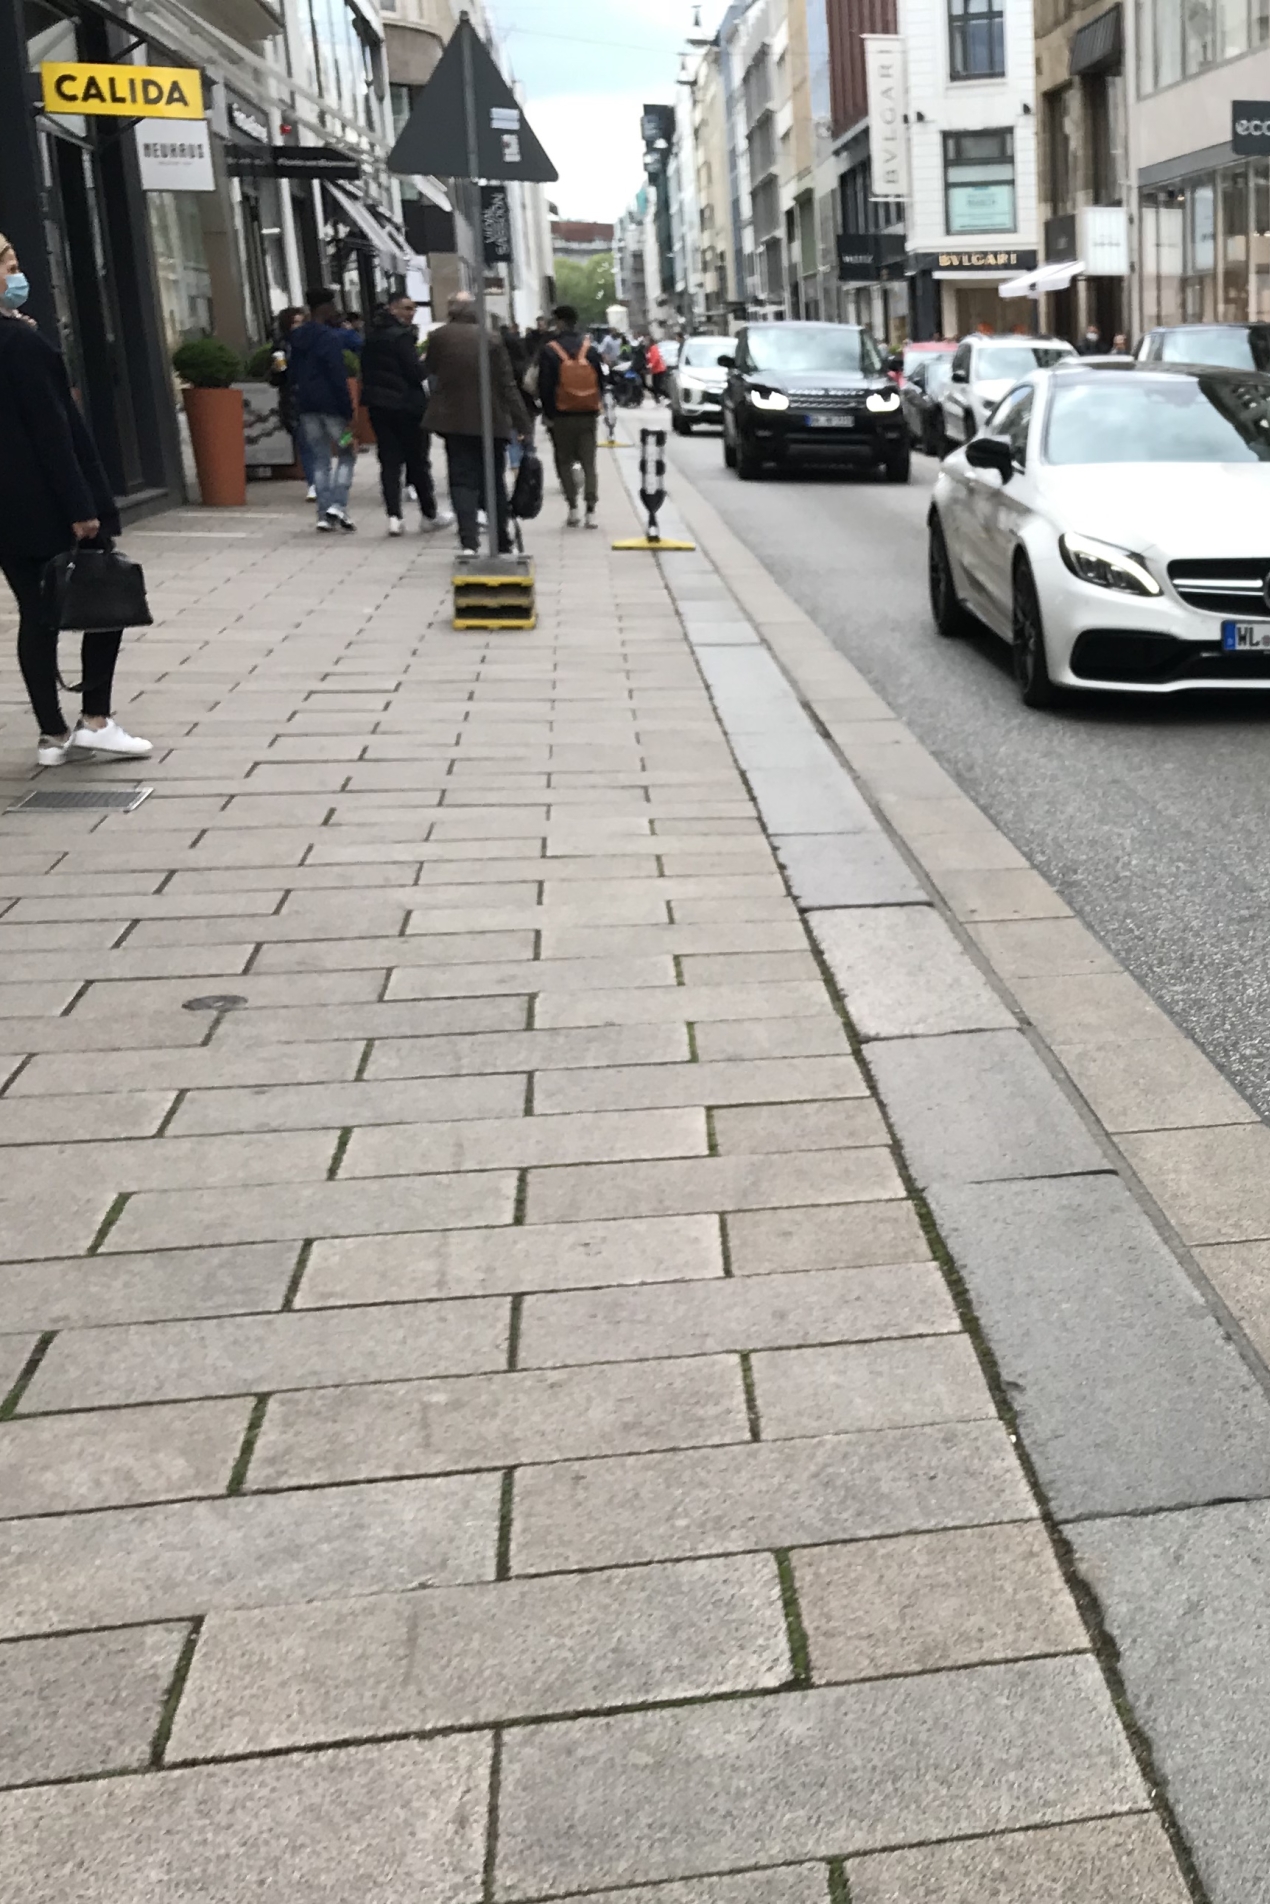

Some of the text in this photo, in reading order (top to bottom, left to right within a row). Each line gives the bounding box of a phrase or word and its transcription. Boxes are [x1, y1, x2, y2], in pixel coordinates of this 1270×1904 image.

[54, 73, 190, 107] CALIDA
[876, 49, 899, 184] BVLGARI
[938, 252, 1017, 267] BVLGARI
